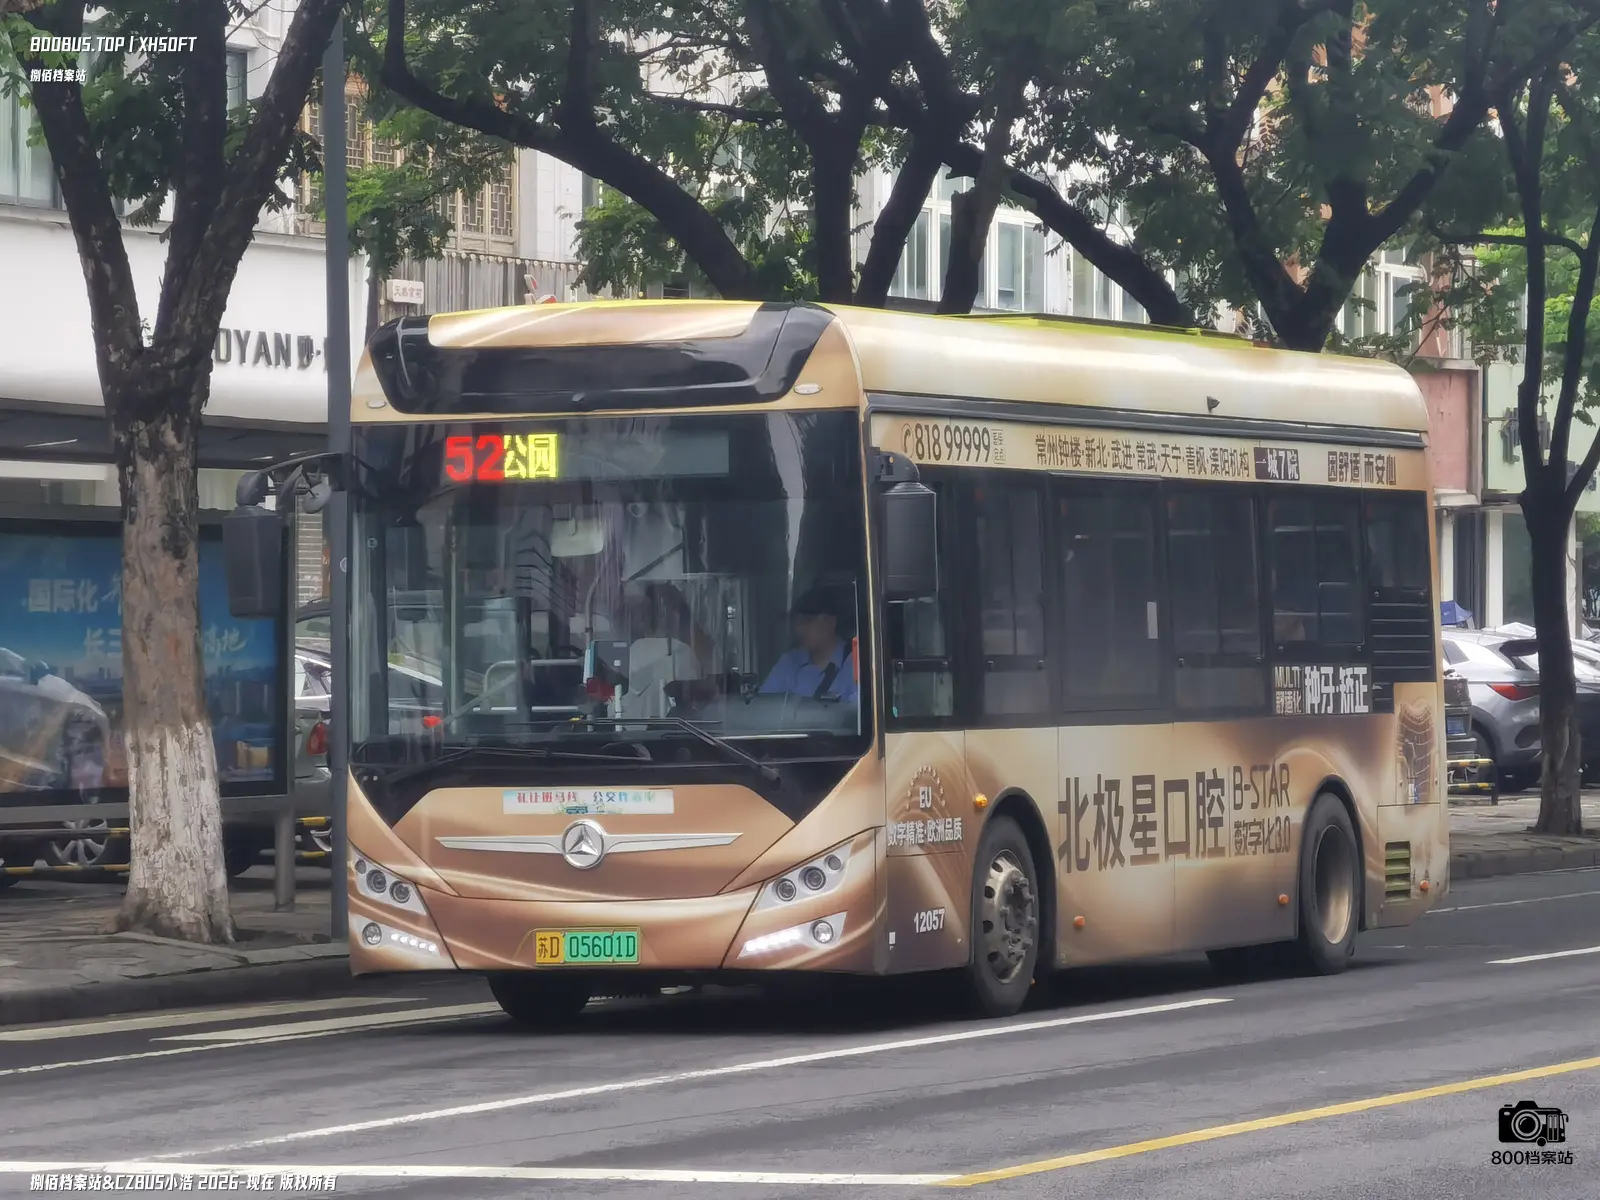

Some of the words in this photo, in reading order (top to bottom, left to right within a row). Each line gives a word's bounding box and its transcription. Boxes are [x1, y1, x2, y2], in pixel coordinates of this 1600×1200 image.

[445, 435, 504, 481] 52
[503, 433, 558, 479] 公园
[1256, 449, 1299, 480] 一城7院
[919, 786, 932, 809] EU
[1233, 763, 1291, 811] B-STAR
[1057, 768, 1226, 873] 北极星口腔
[1233, 815, 1291, 857] 数字化3.0
[913, 907, 946, 934] 12057
[537, 936, 560, 959] 苏D
[569, 935, 636, 958] 05601D
